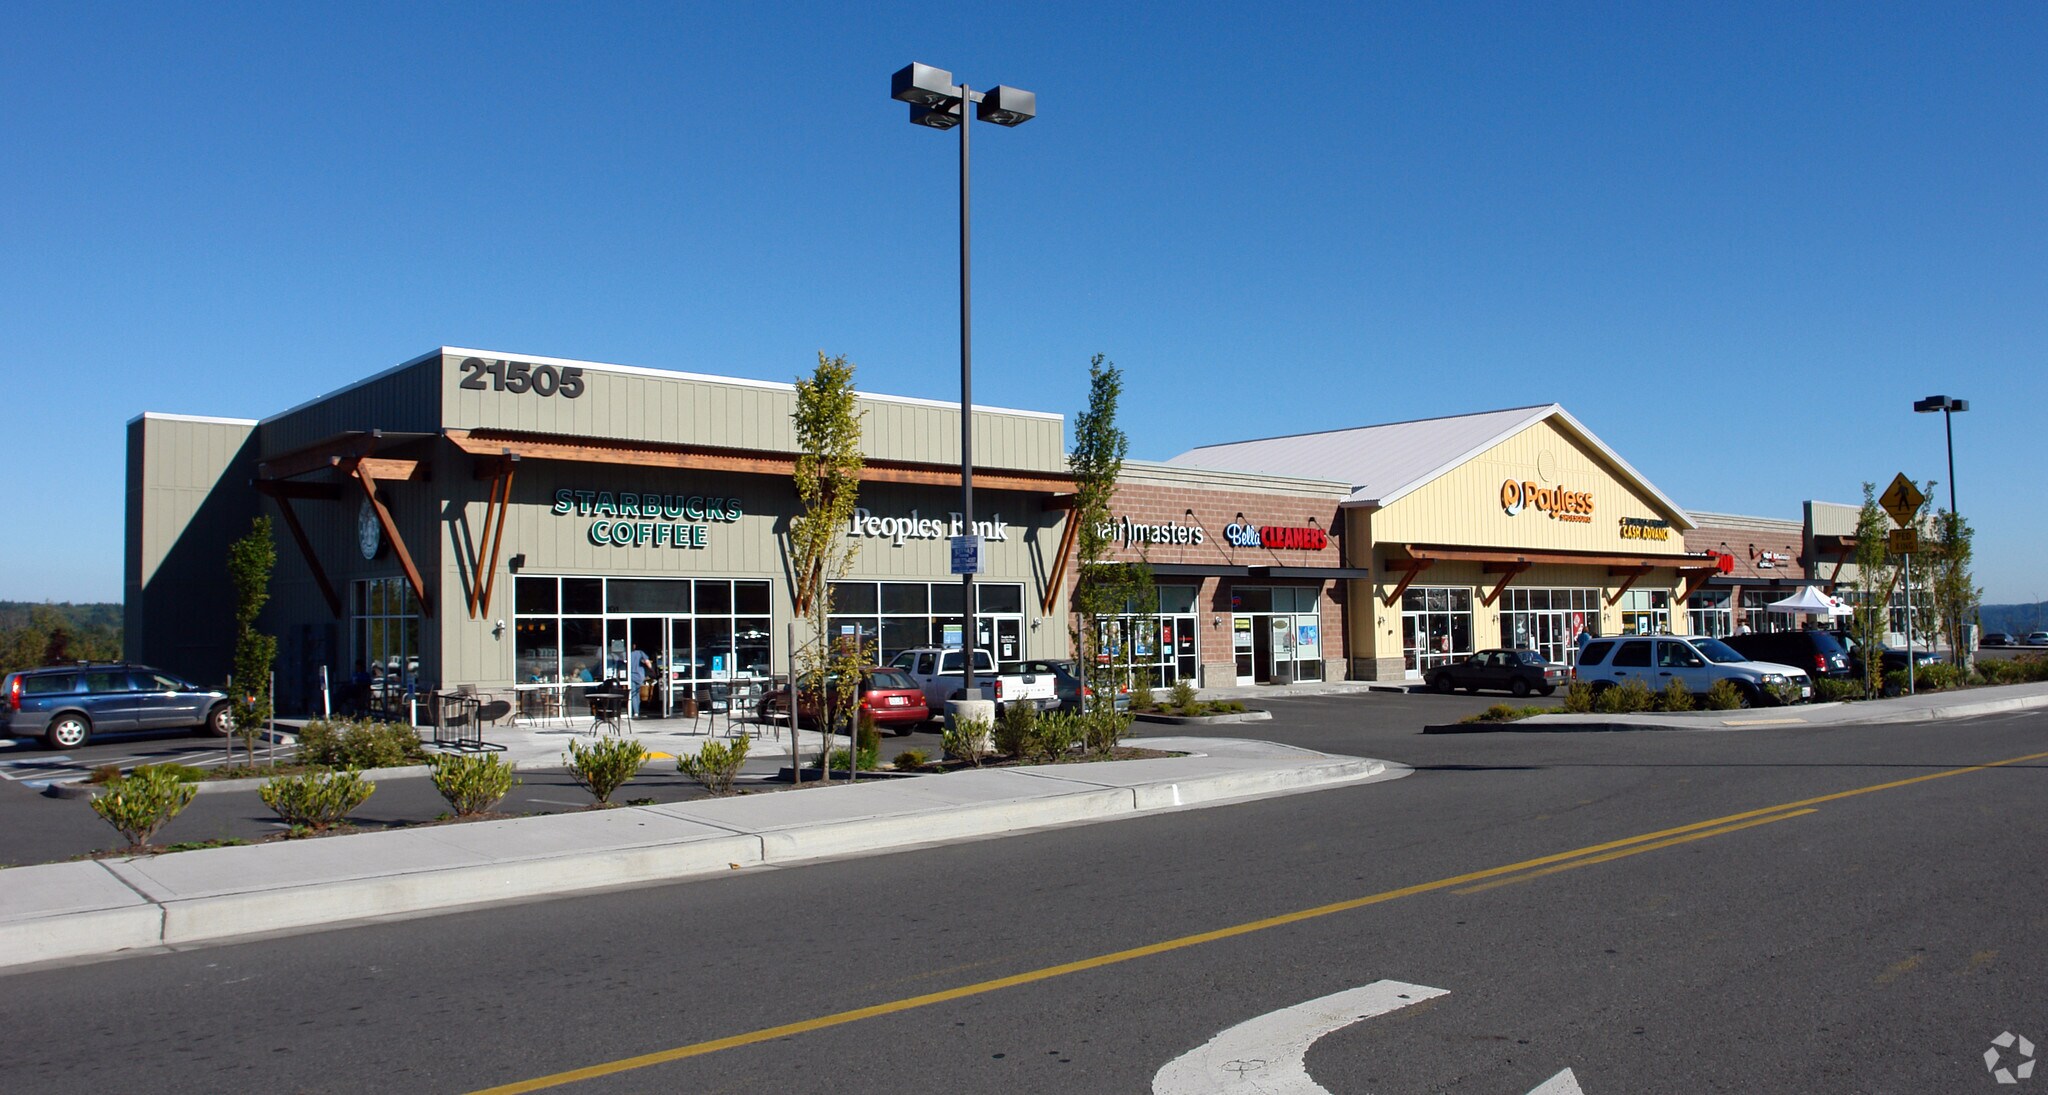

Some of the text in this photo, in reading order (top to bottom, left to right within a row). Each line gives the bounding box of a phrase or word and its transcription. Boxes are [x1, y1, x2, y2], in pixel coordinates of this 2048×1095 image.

[460, 357, 585, 399] 21505
[554, 488, 743, 521] STARBUCKS
[1523, 481, 1595, 518] Payless
[591, 520, 709, 547] COFFEE
[851, 507, 942, 545] Peoples
[1226, 523, 1327, 549] Bella CLEANERS
[1623, 525, 1640, 539] CASH
[1896, 532, 1912, 541] PED
